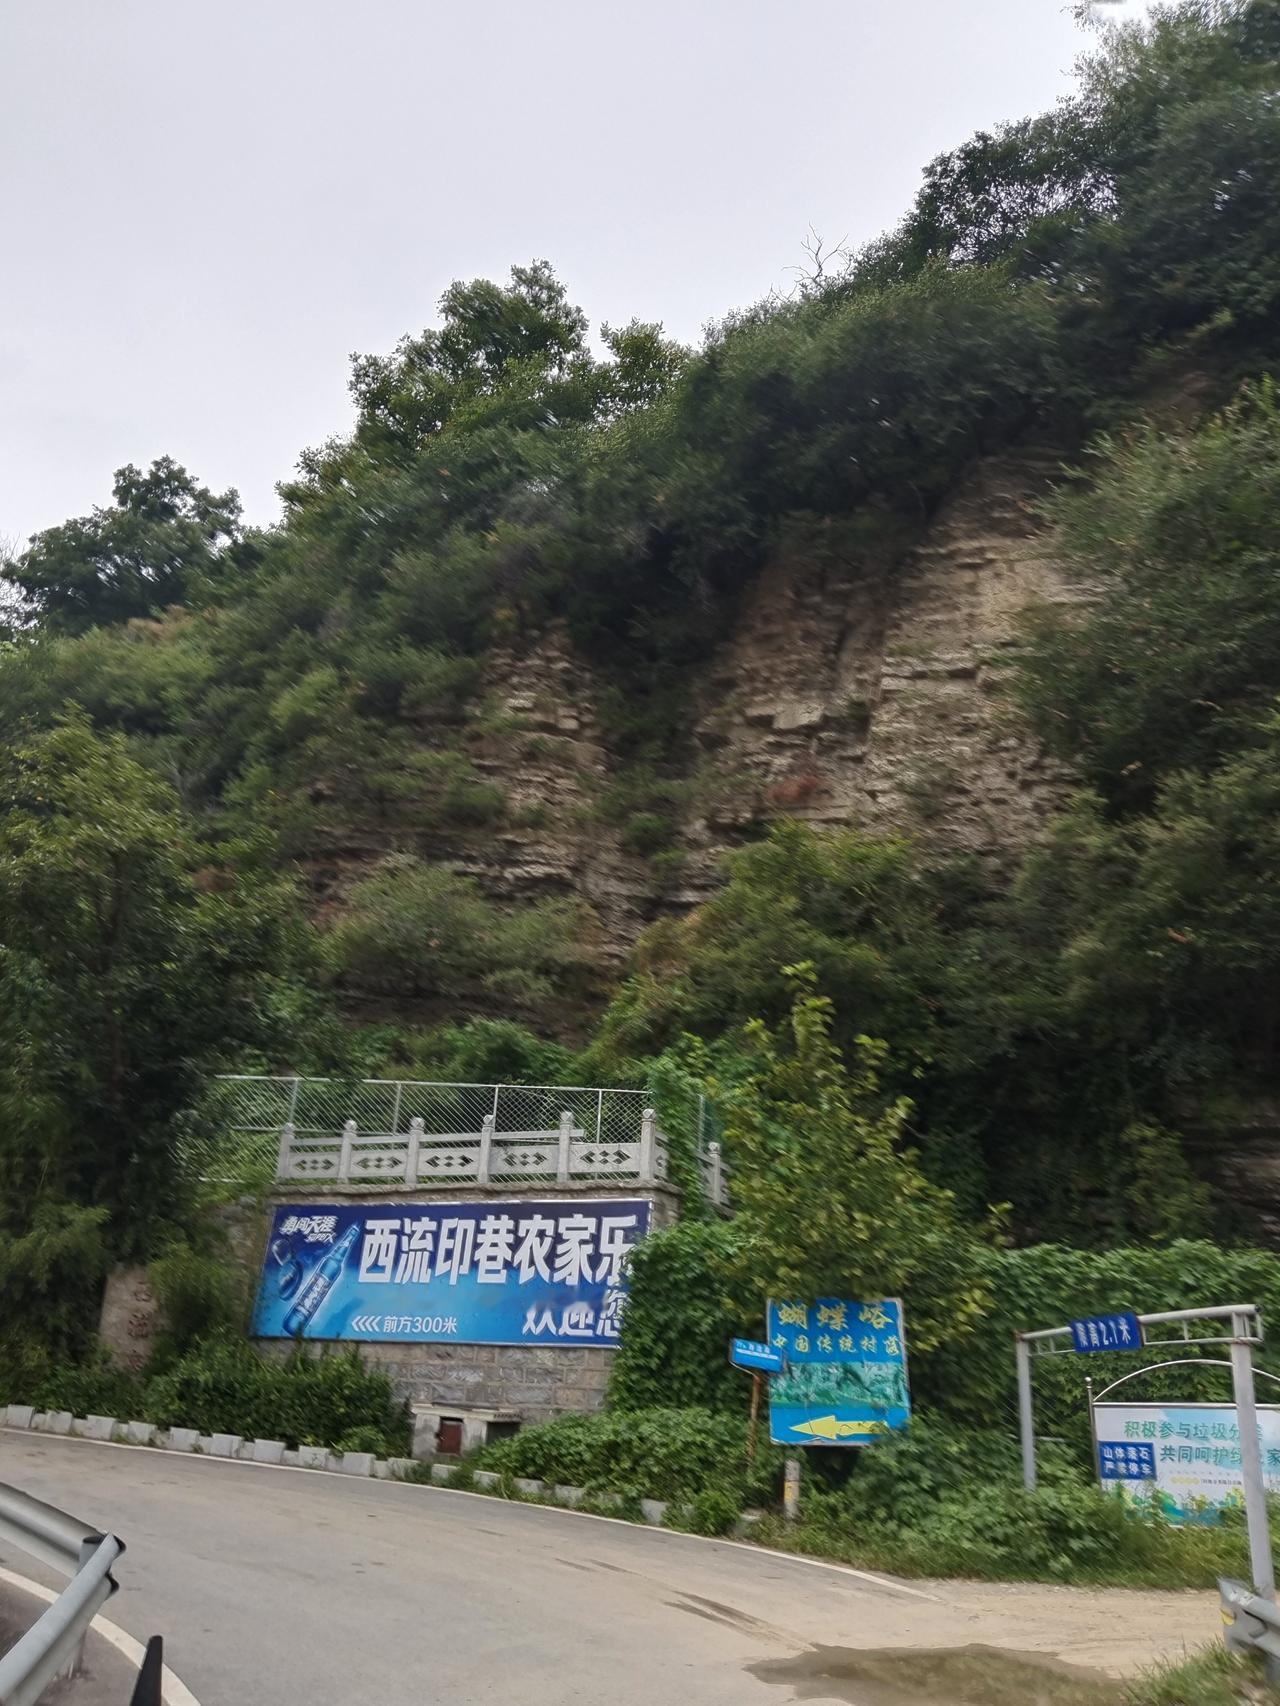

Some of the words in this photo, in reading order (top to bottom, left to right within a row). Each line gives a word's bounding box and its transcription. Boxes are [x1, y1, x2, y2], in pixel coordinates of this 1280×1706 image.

[357, 1213, 638, 1285] 西流印巷农家乐
[383, 1315, 458, 1334] 前方300米
[1160, 1444, 1280, 1466] 共同呵护绿家
